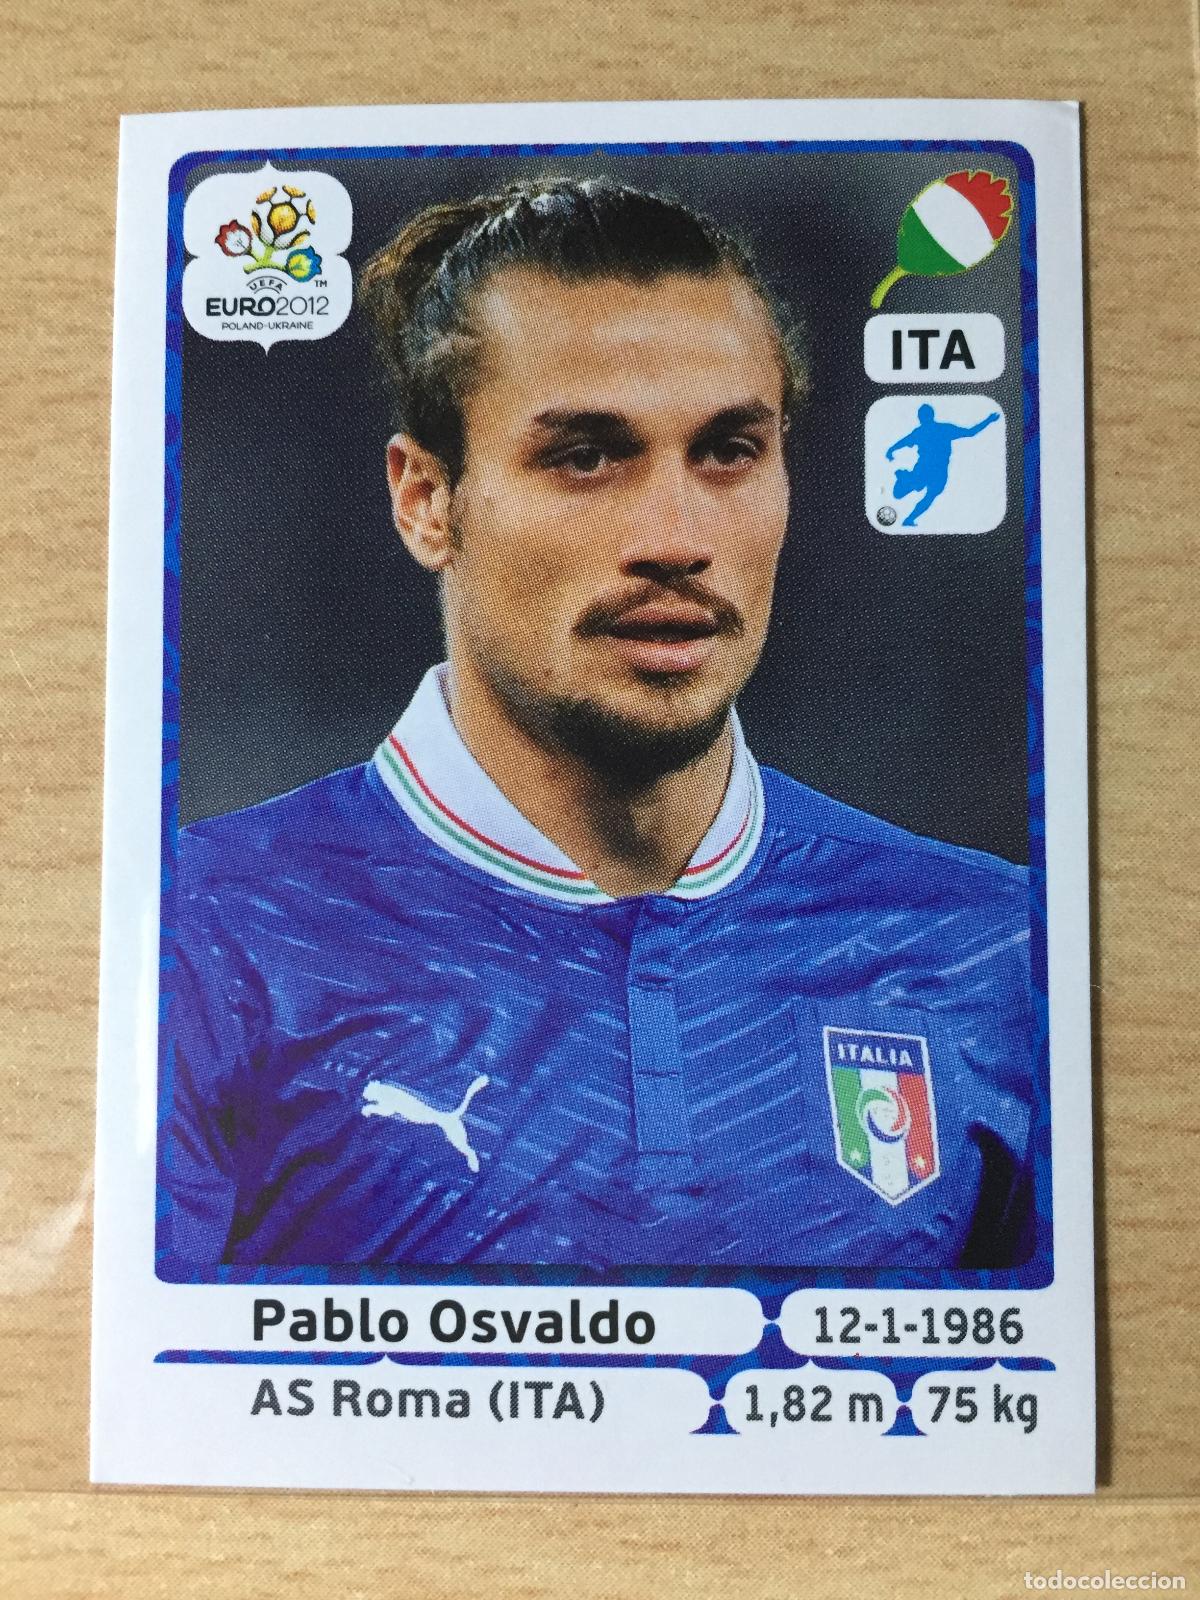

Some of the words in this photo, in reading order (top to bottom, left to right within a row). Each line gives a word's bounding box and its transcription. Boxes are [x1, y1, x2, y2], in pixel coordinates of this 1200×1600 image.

[249, 279, 283, 291] UEFA
[205, 296, 329, 317] EURO2012
[221, 321, 314, 331] POLAND-UKRAINE
[892, 329, 976, 370] ITA
[837, 1043, 913, 1066] ITALIA
[252, 1297, 409, 1342] Pablo
[429, 1298, 656, 1345] Osvaldo
[814, 1306, 1024, 1345] 12-1-1986
[250, 1378, 315, 1417] AS
[332, 1379, 470, 1418] Roma
[489, 1379, 605, 1423] (ITA)
[745, 1384, 833, 1428] 1,82
[848, 1392, 884, 1423] m
[928, 1385, 978, 1424] 75
[993, 1383, 1038, 1434] kg
